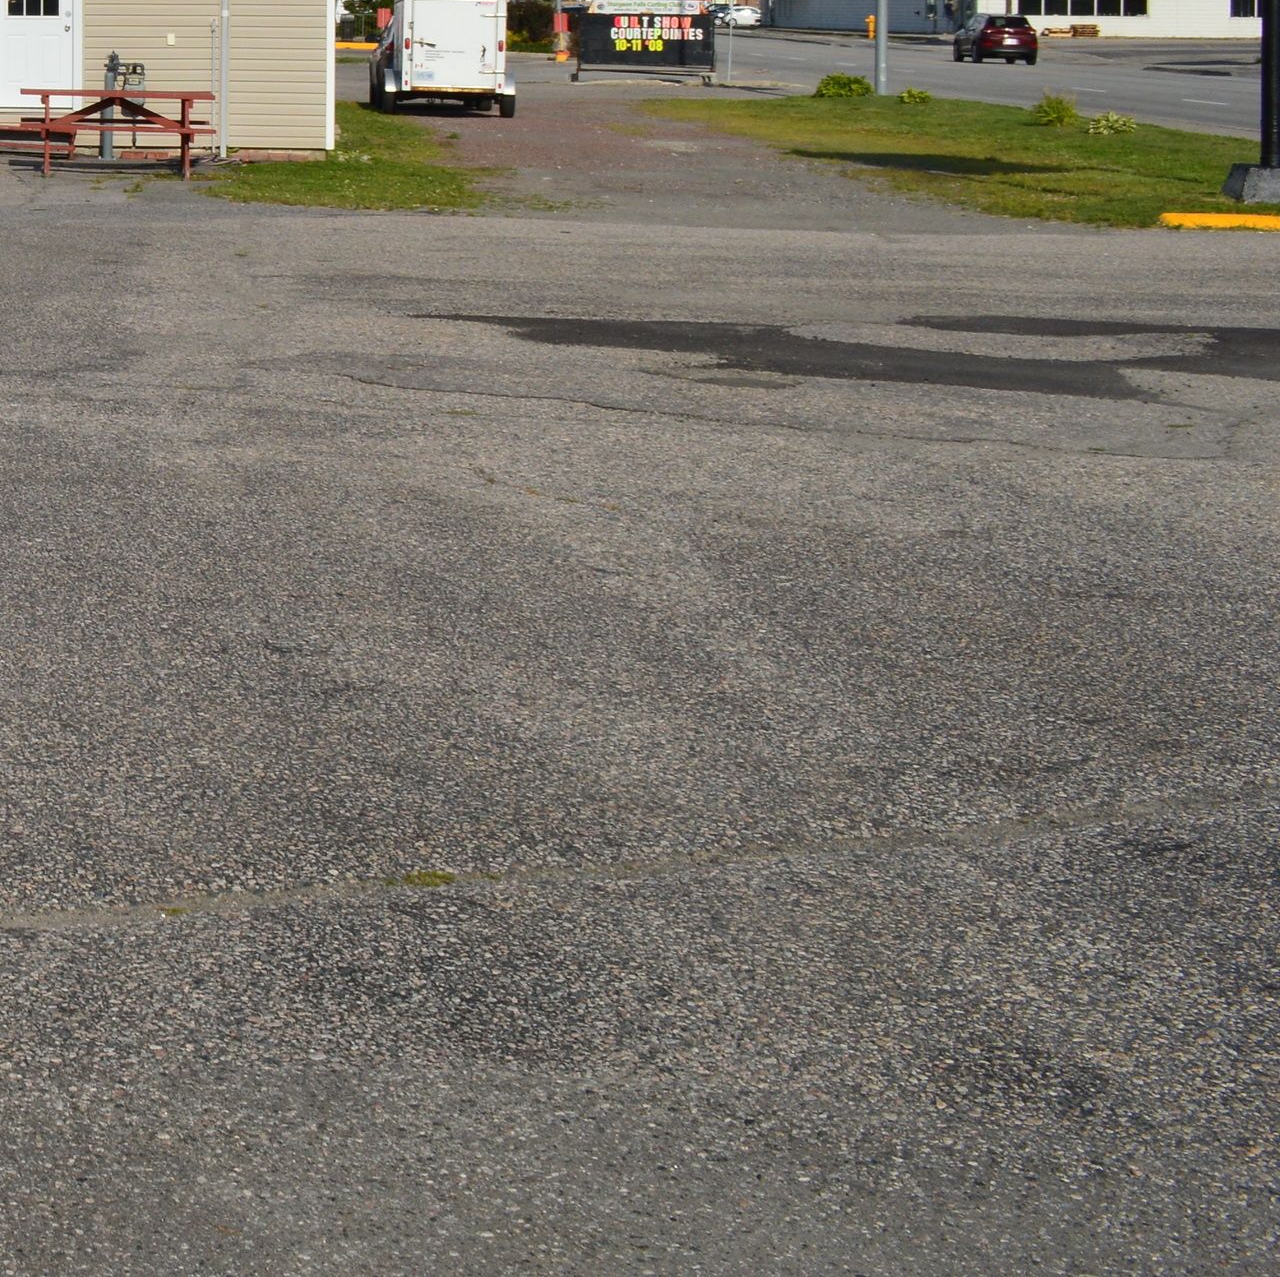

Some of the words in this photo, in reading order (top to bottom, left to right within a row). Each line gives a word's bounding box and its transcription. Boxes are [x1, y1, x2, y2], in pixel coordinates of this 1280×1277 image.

[653, 16, 692, 28] SHOW
[610, 28, 703, 40] COURTEPOINTES
[614, 39, 642, 51] 10-11
